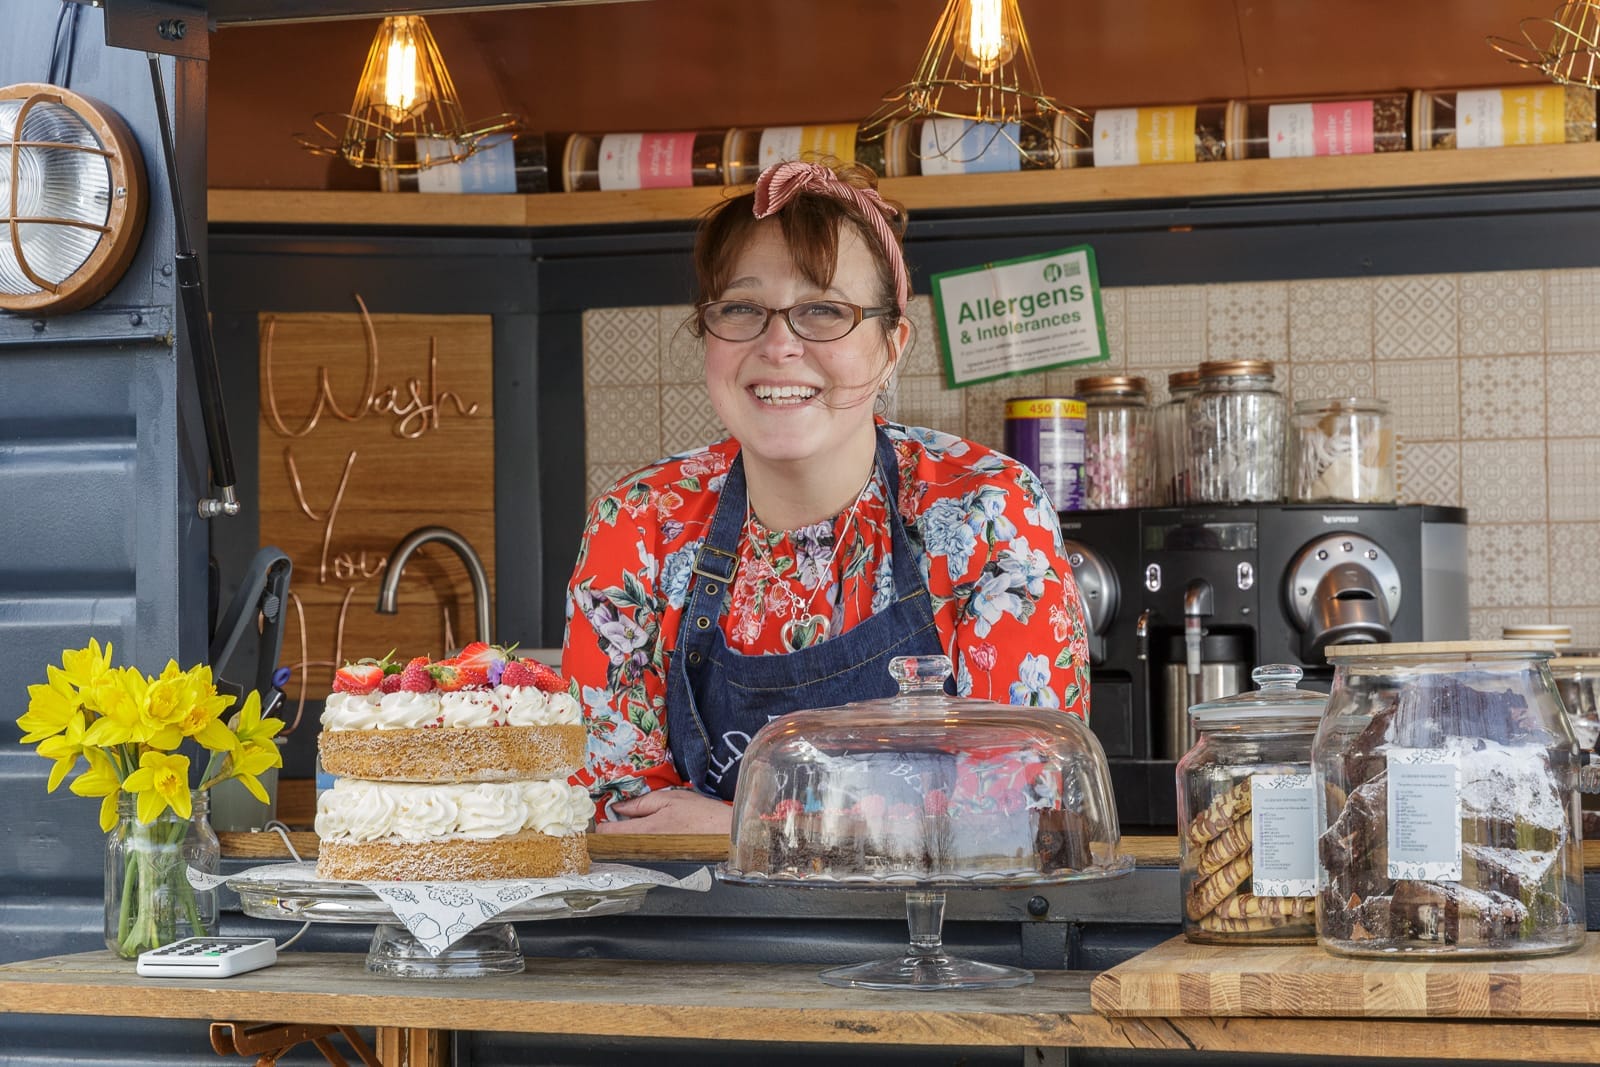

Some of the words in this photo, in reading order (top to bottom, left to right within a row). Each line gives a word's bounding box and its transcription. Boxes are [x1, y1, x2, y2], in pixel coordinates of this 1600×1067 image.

[958, 284, 1085, 325] Allergens
[960, 330, 972, 345] &
[977, 311, 1081, 341] Intolerances
[267, 294, 478, 438] Wash
[286, 450, 423, 584] You
